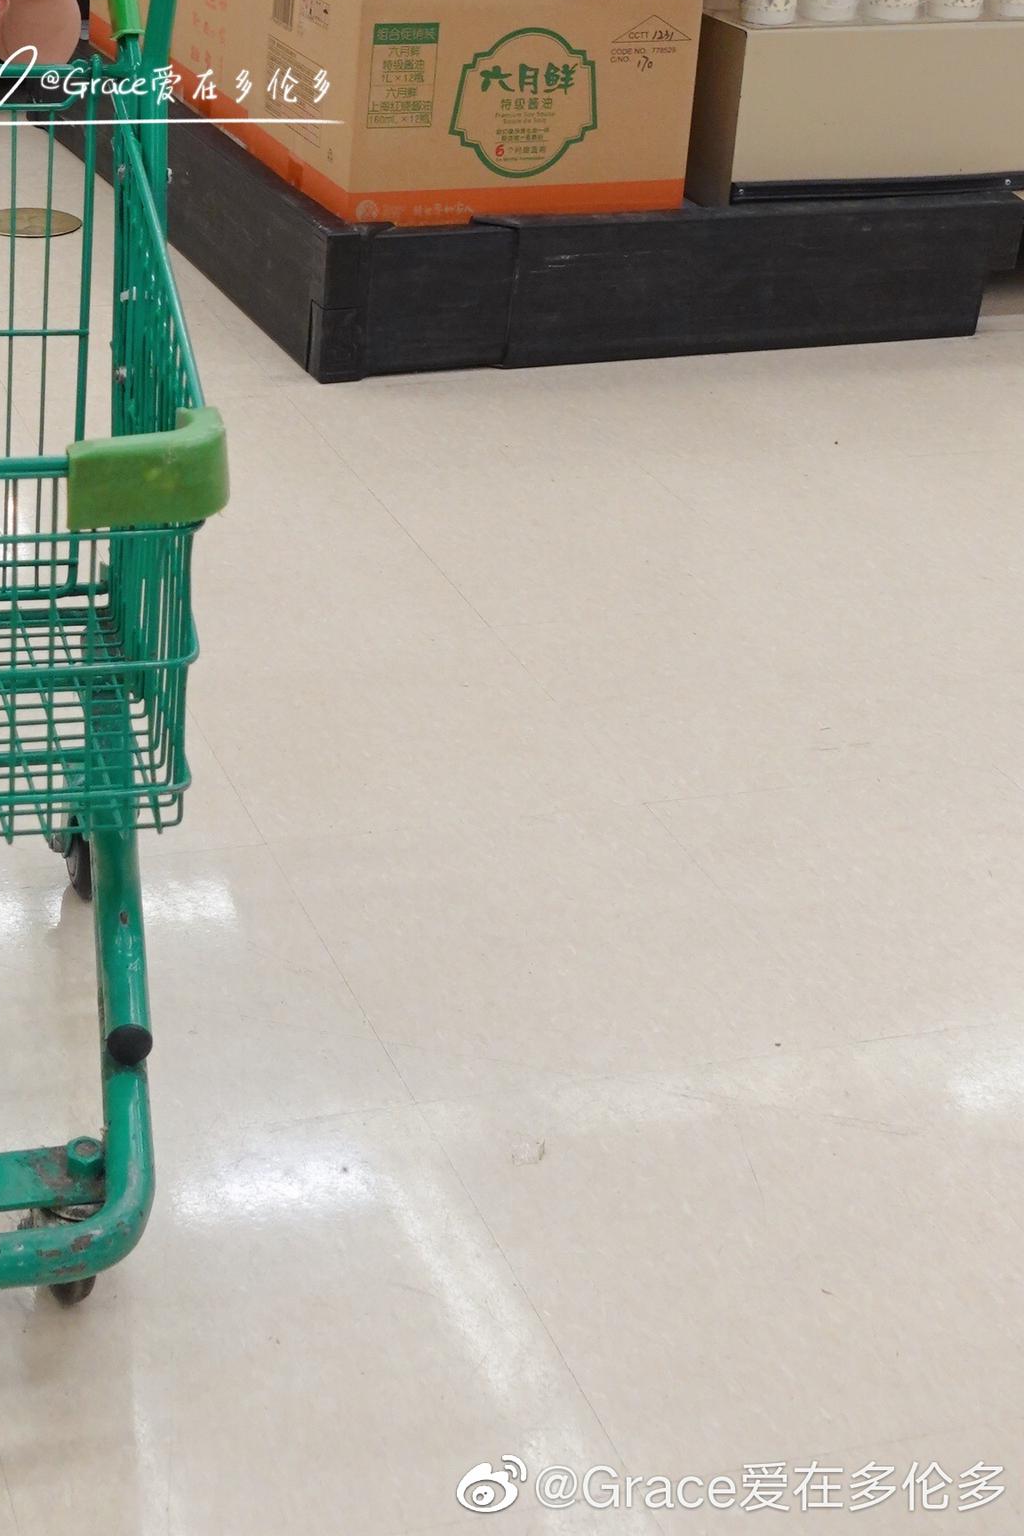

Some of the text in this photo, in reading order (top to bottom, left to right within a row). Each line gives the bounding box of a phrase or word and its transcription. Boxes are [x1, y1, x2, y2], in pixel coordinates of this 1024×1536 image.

[610, 47, 633, 56] CODE
[479, 62, 579, 96] 六月鲜
